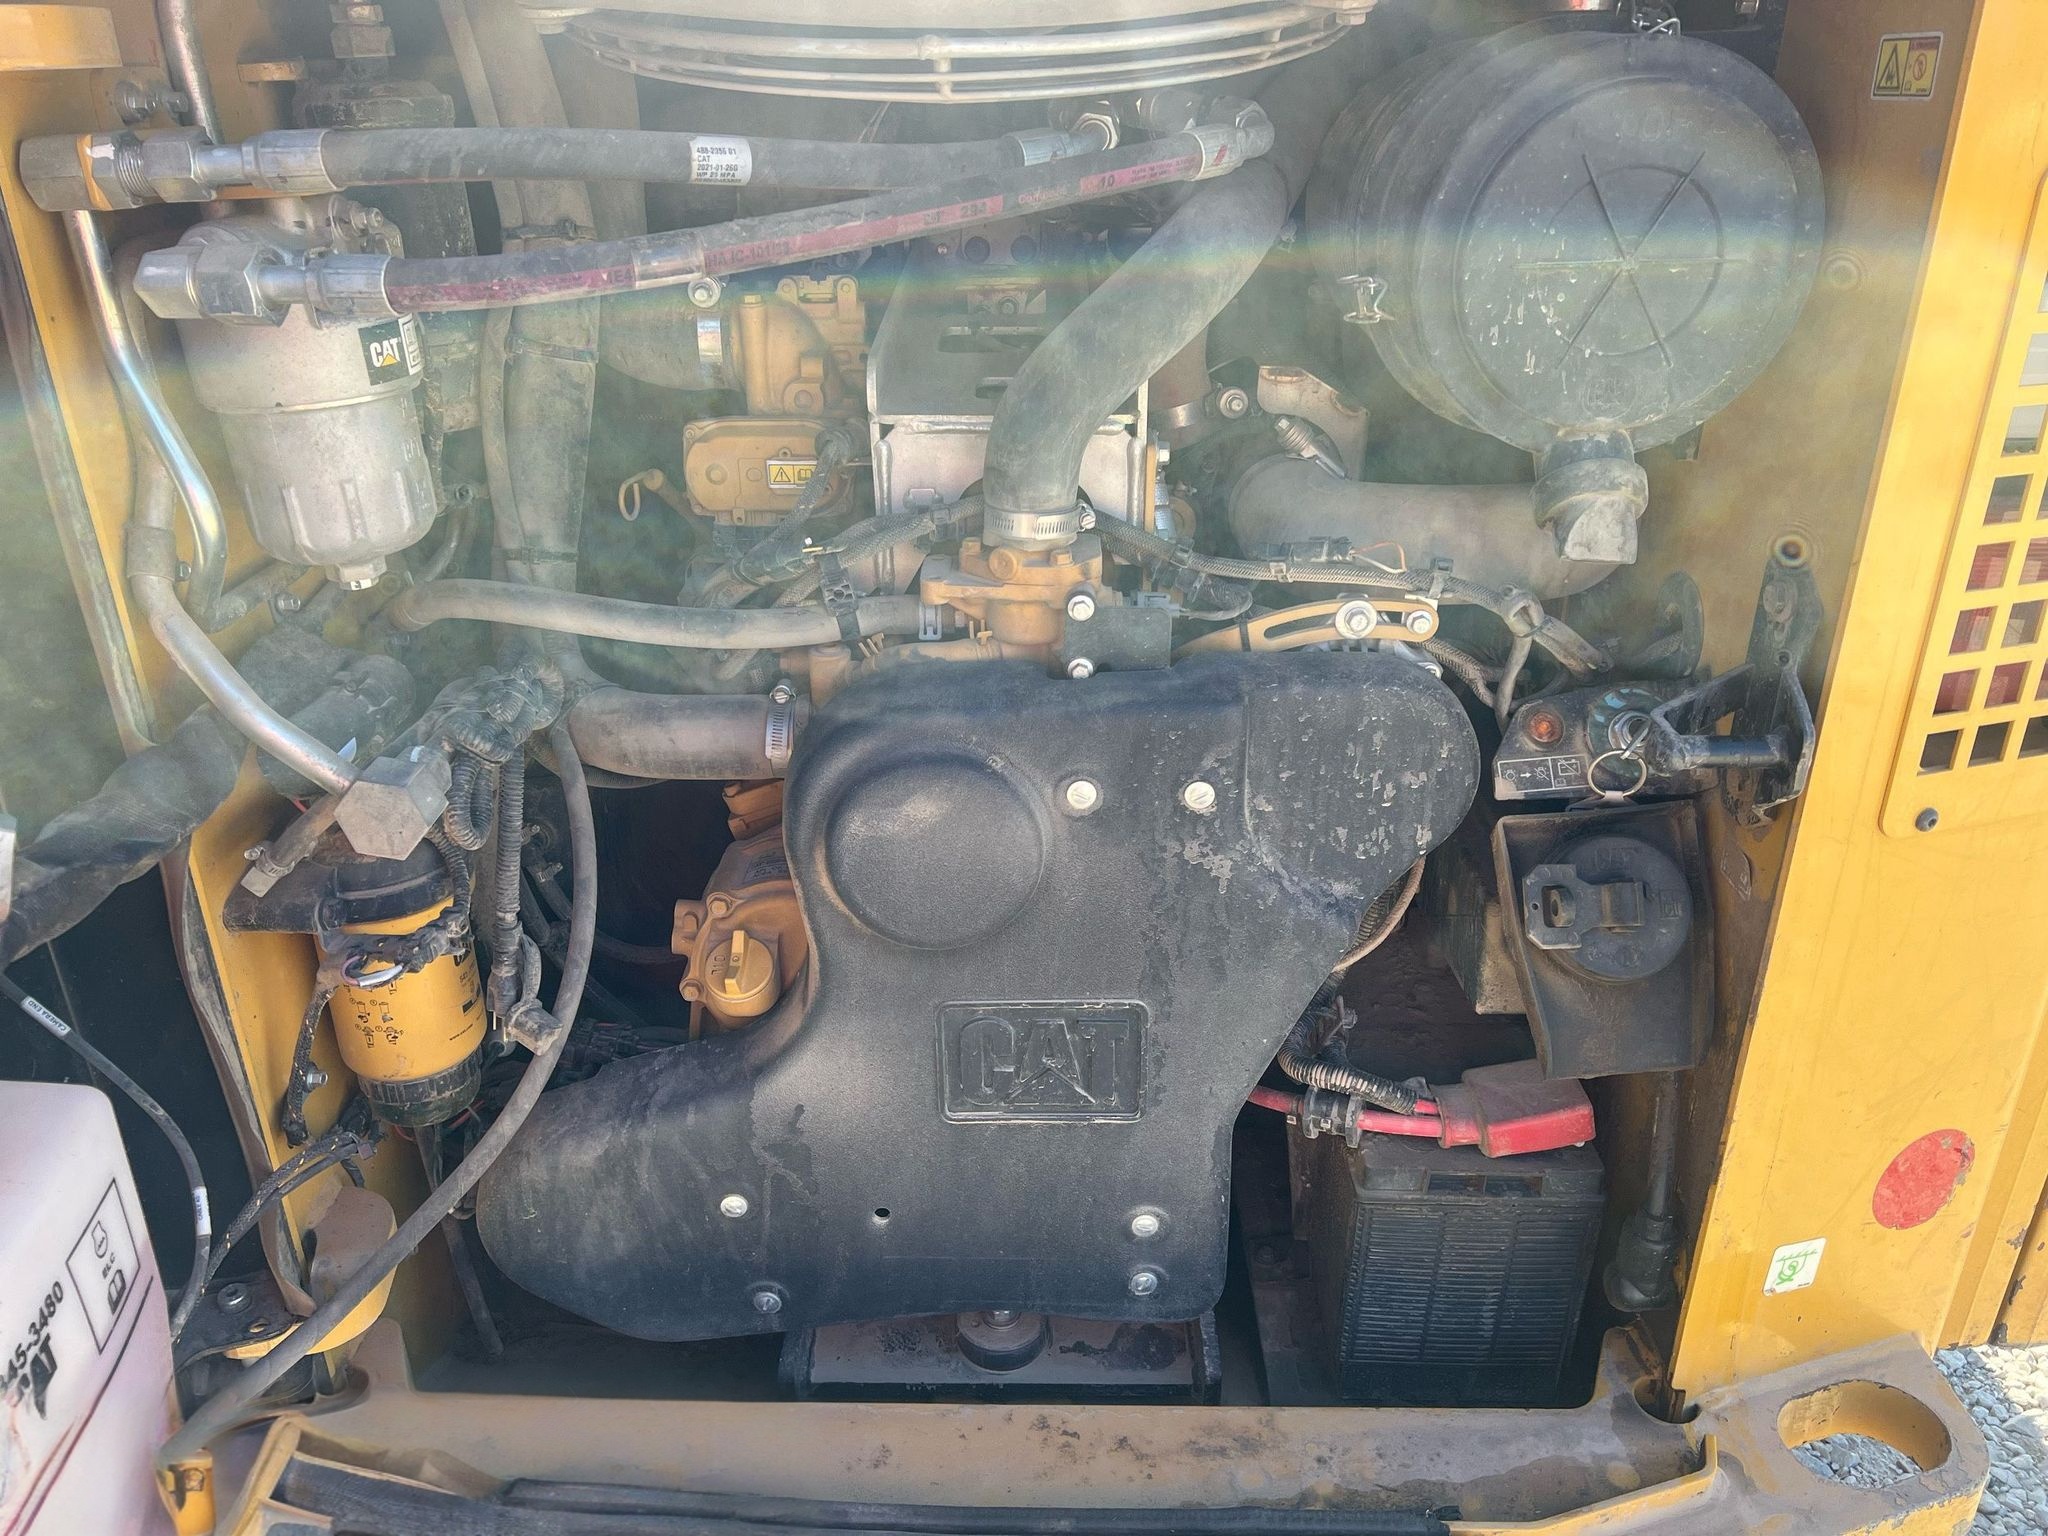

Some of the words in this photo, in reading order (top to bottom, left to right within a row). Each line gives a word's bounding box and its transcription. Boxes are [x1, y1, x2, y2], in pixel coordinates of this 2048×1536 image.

[369, 337, 401, 369] CAT
[711, 954, 726, 976] OIL
[27, 1000, 42, 1013] END
[41, 1010, 68, 1032] CAMERA
[958, 1015, 1130, 1106] CAT
